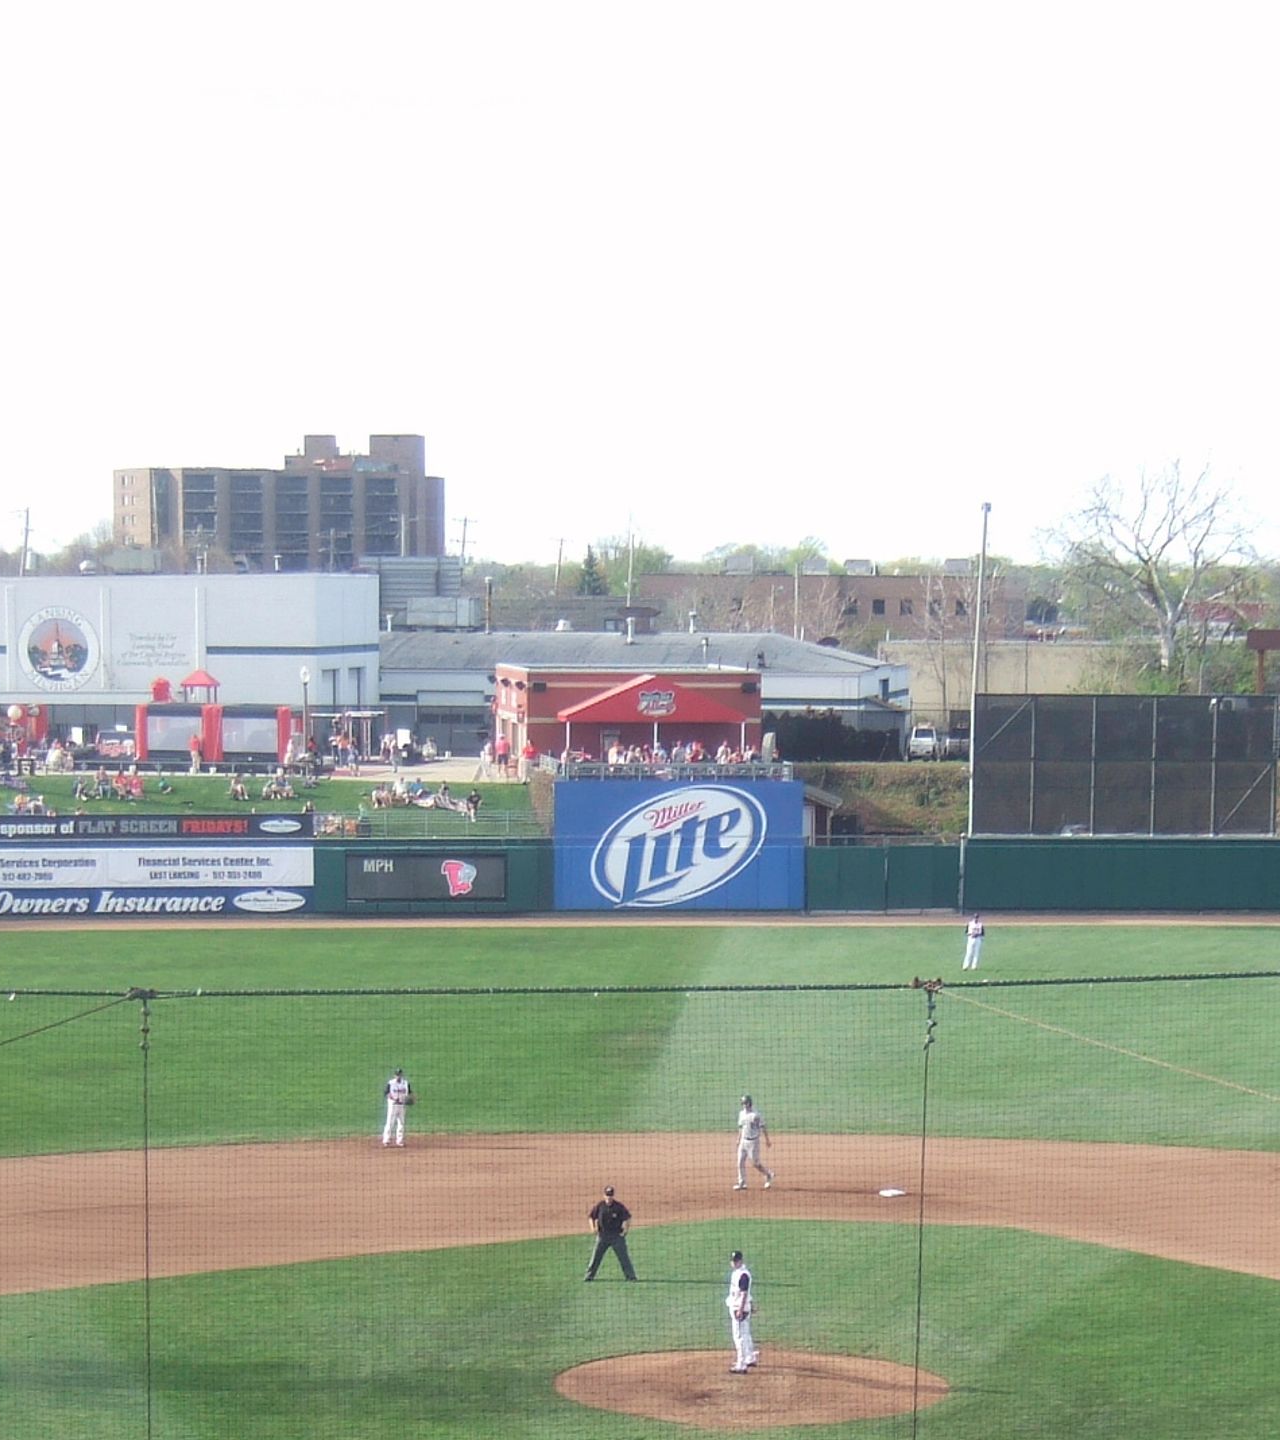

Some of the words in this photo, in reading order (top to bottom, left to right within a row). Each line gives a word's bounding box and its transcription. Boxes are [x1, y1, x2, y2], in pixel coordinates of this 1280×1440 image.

[642, 800, 705, 831] Miller
[0, 822, 56, 837] sponsor
[60, 821, 74, 835] of
[78, 820, 116, 834] FLAT
[120, 820, 177, 834] SCREEN
[182, 819, 249, 834] FRIDAYS!
[0, 858, 39, 867] Services
[42, 858, 97, 868] Corporation
[138, 857, 180, 867] Financial
[182, 857, 221, 867] Services
[618, 807, 763, 907] Lite
[363, 860, 394, 873] MPH
[94, 890, 225, 914] Insurance
